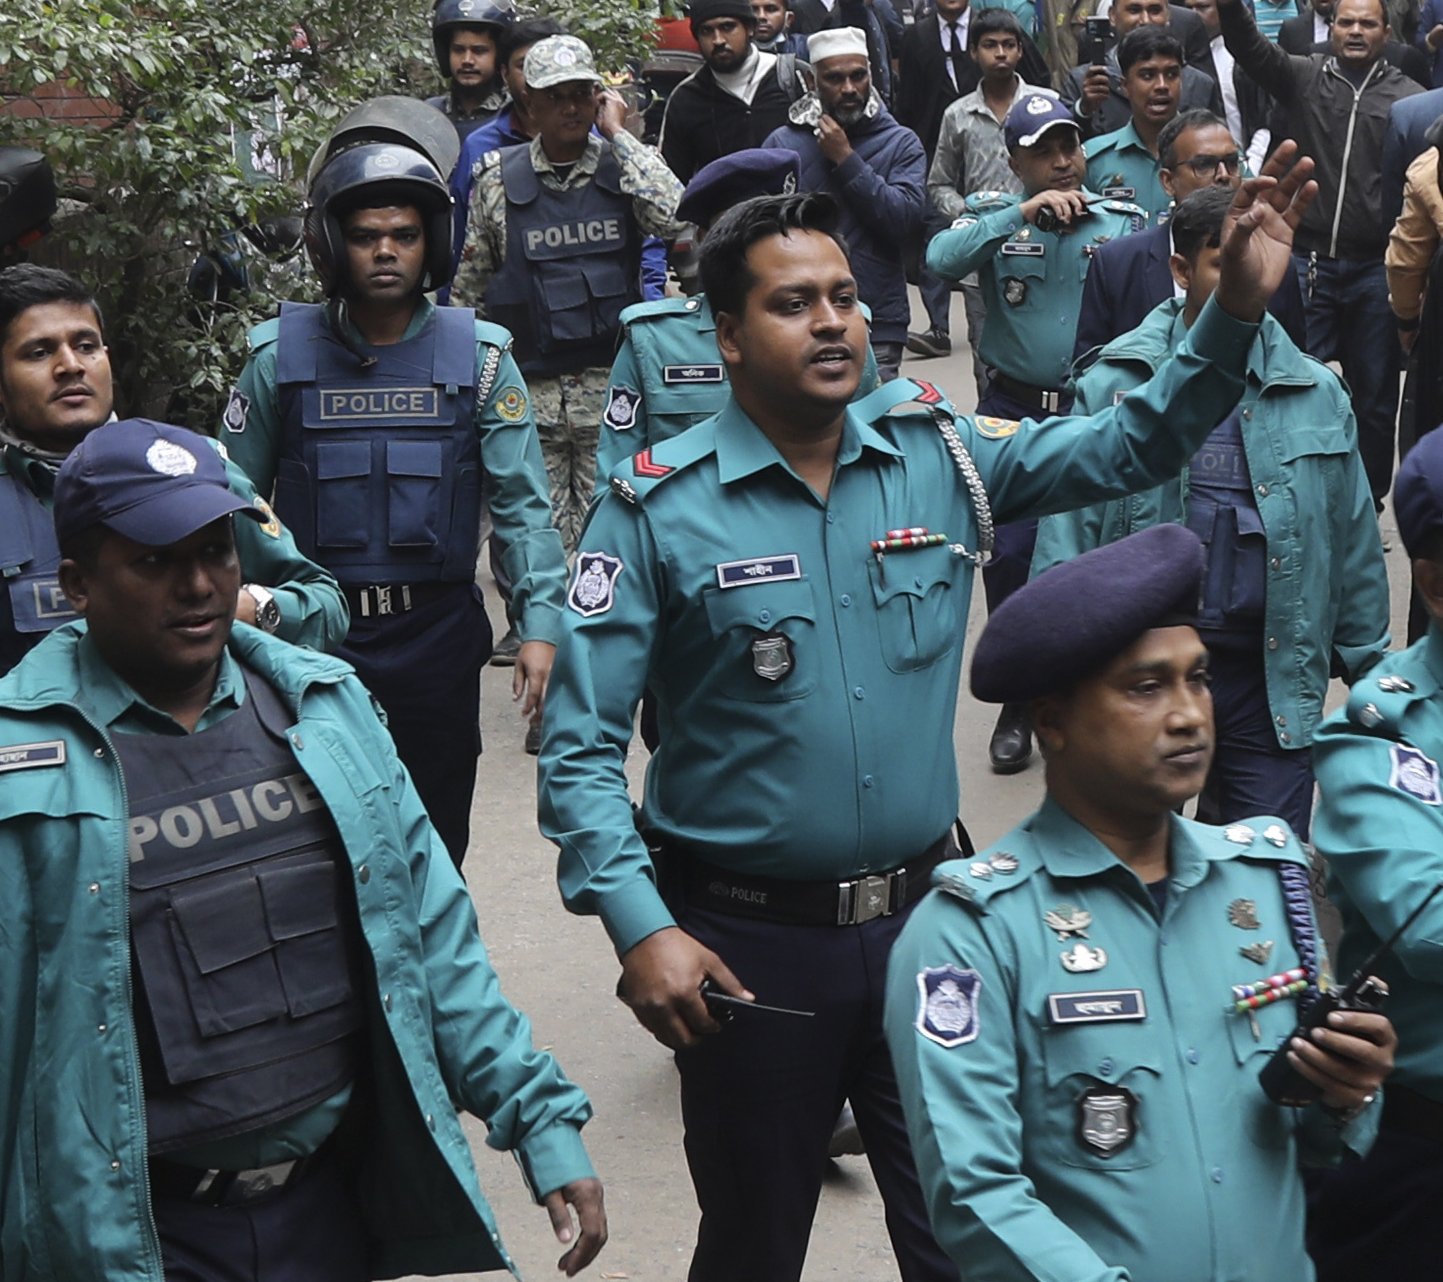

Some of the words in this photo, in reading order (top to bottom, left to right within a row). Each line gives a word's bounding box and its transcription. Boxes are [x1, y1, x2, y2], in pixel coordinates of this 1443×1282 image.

[527, 219, 621, 251] POLICE
[332, 390, 425, 413] POLICE
[129, 773, 325, 864] POLICE
[731, 886, 768, 905] POLICE
